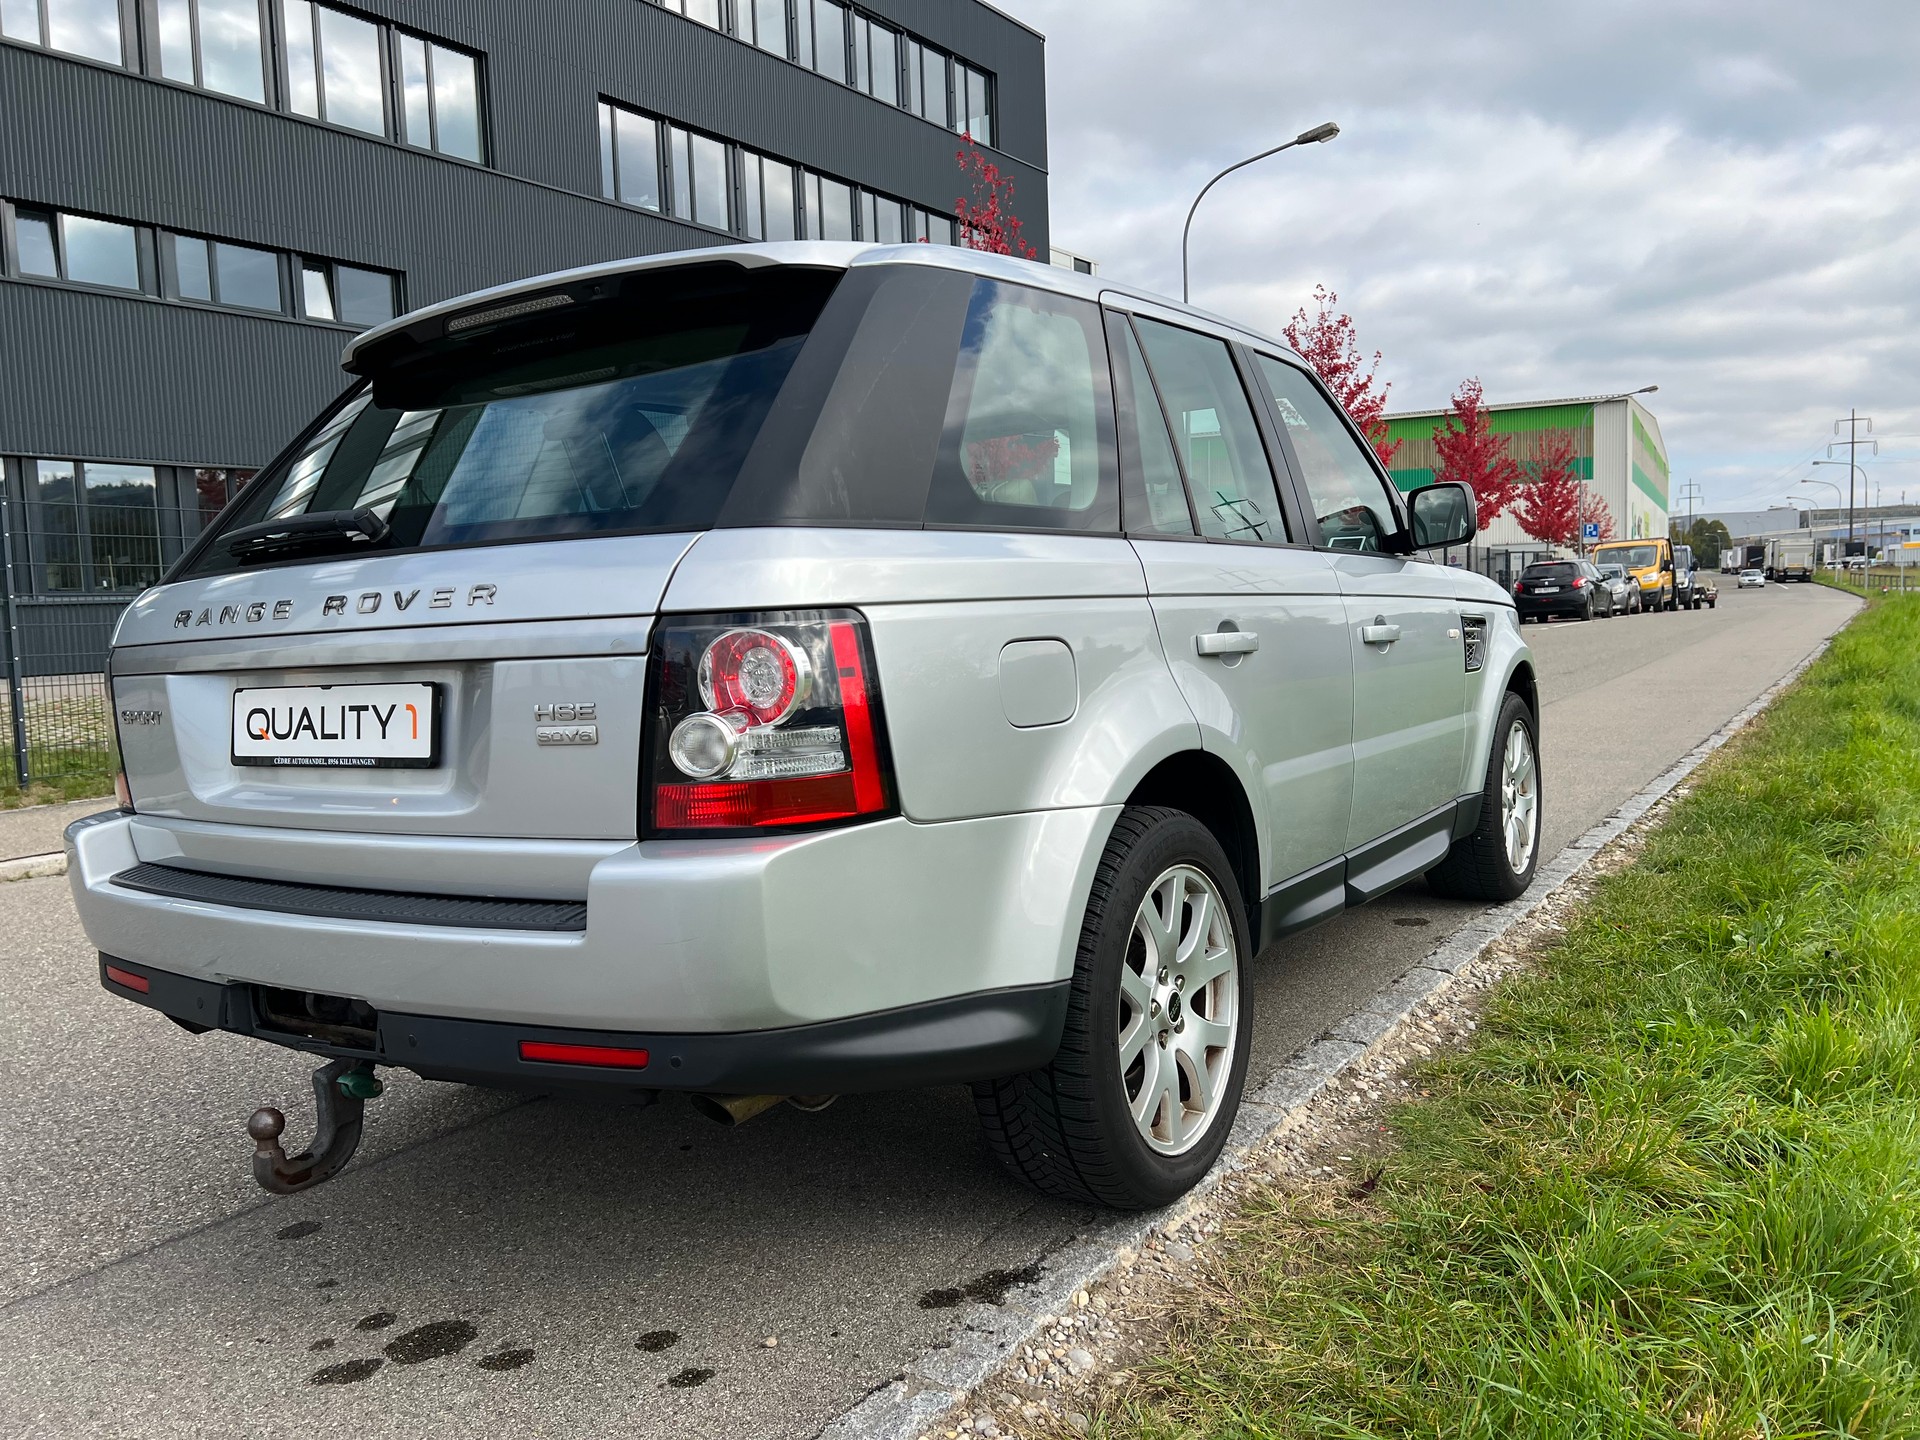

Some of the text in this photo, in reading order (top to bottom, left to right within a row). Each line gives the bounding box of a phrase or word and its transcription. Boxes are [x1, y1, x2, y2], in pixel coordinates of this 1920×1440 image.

[174, 583, 497, 629] RANGE ROVER
[121, 710, 163, 726] SPORT
[533, 702, 597, 722] HSE
[246, 703, 418, 741] QUALITY 1
[537, 728, 593, 743] SDV6
[292, 757, 327, 766] AUTOHANDEL,
[340, 758, 376, 766] KILLWANGEN
